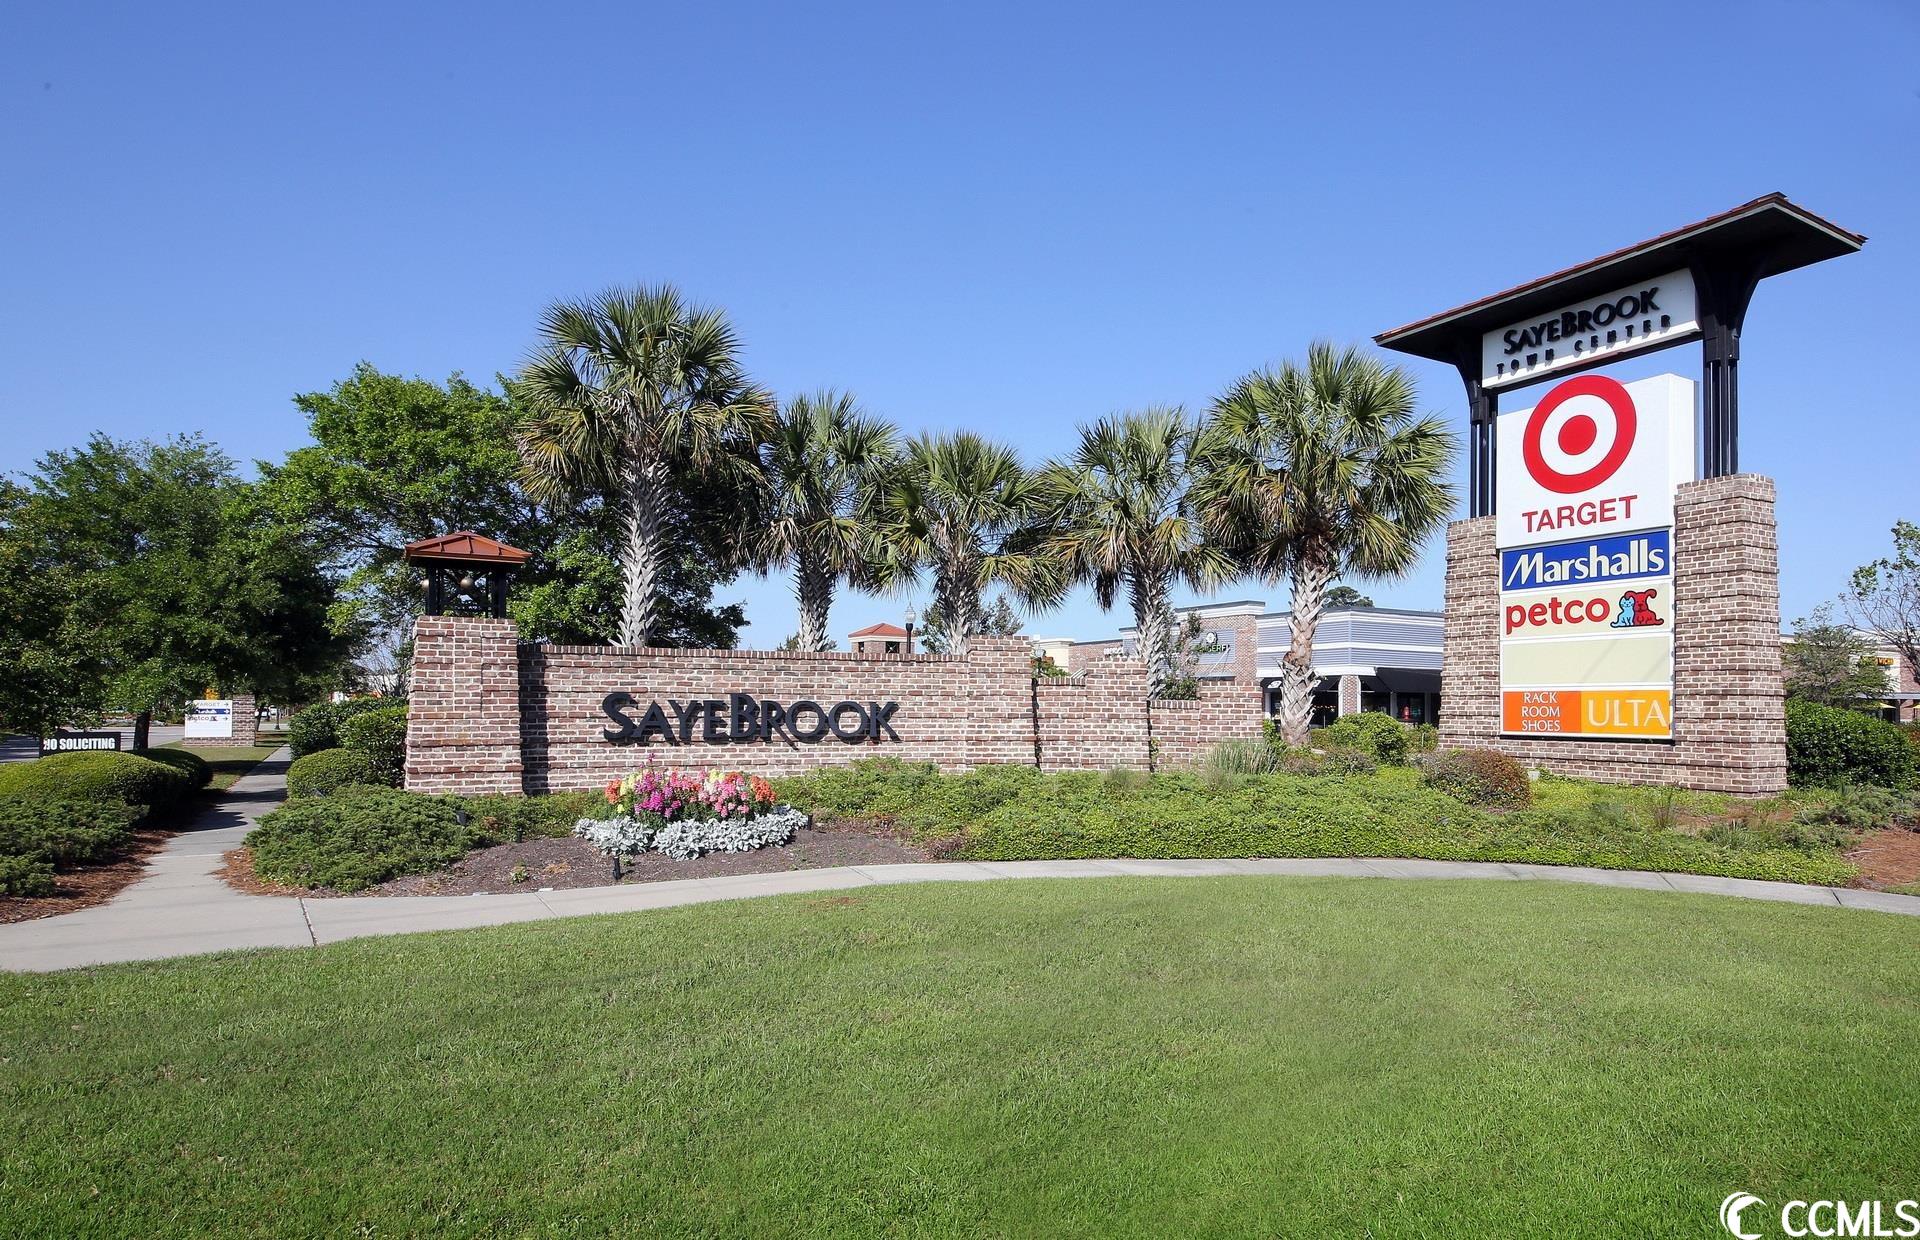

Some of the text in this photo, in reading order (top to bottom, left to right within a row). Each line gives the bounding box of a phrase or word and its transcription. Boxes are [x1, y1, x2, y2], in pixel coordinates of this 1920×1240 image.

[1503, 286, 1660, 355] SAYEBROOK
[1496, 314, 1672, 376] TOWN CENTER
[1522, 494, 1638, 533] TARGET
[1505, 538, 1665, 587] Marshalls
[1505, 597, 1611, 636] petco
[1521, 705, 1561, 718] ROOM
[1523, 691, 1558, 704] RACK
[1588, 699, 1668, 728] ULTA
[601, 691, 901, 748] SAYEBROOK
[1521, 719, 1561, 732] SHOES
[59, 737, 116, 750] SOLICITING
